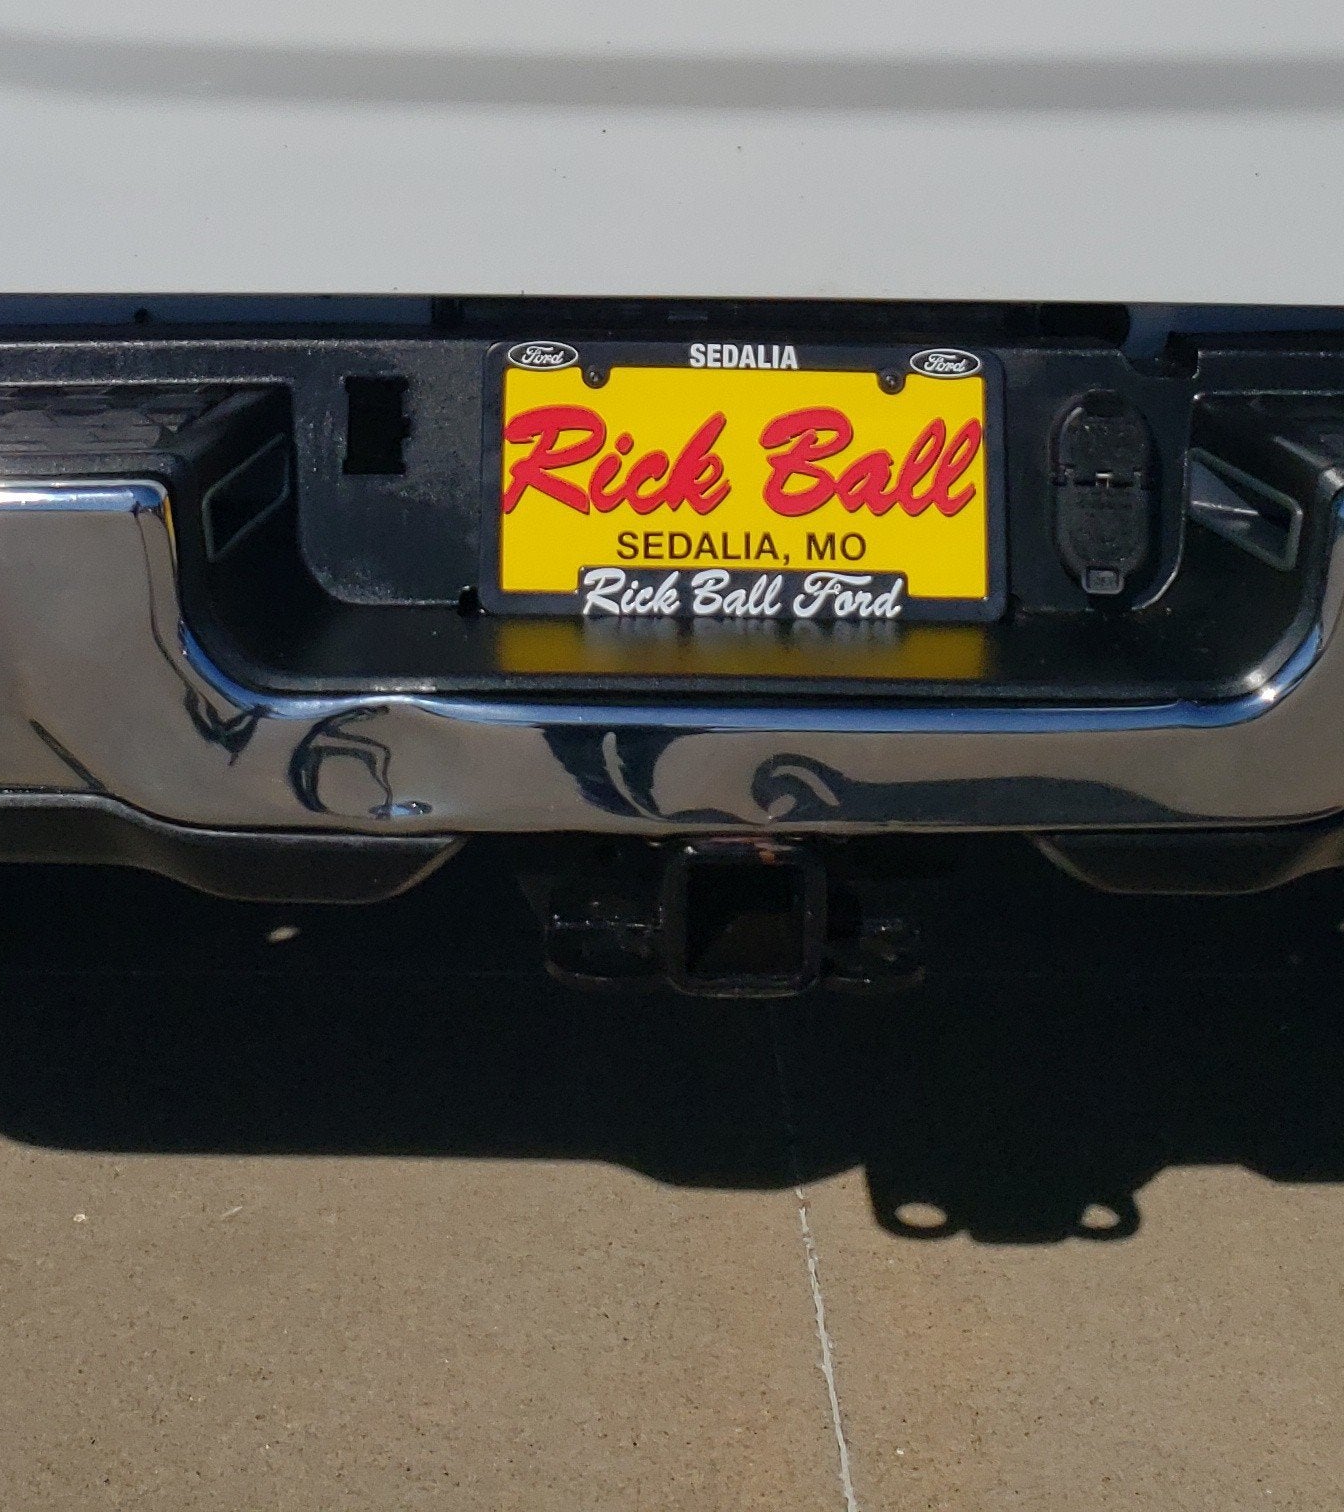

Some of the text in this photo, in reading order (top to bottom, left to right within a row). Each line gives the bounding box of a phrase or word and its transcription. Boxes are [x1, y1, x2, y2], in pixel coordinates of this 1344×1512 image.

[522, 345, 564, 365] Ford
[690, 343, 799, 369] SEDALIA
[924, 353, 966, 372] Ford
[503, 404, 983, 518] Rick Ball
[617, 531, 867, 566] SEDALIA, MO
[582, 568, 903, 620] Rick Ball Ford
